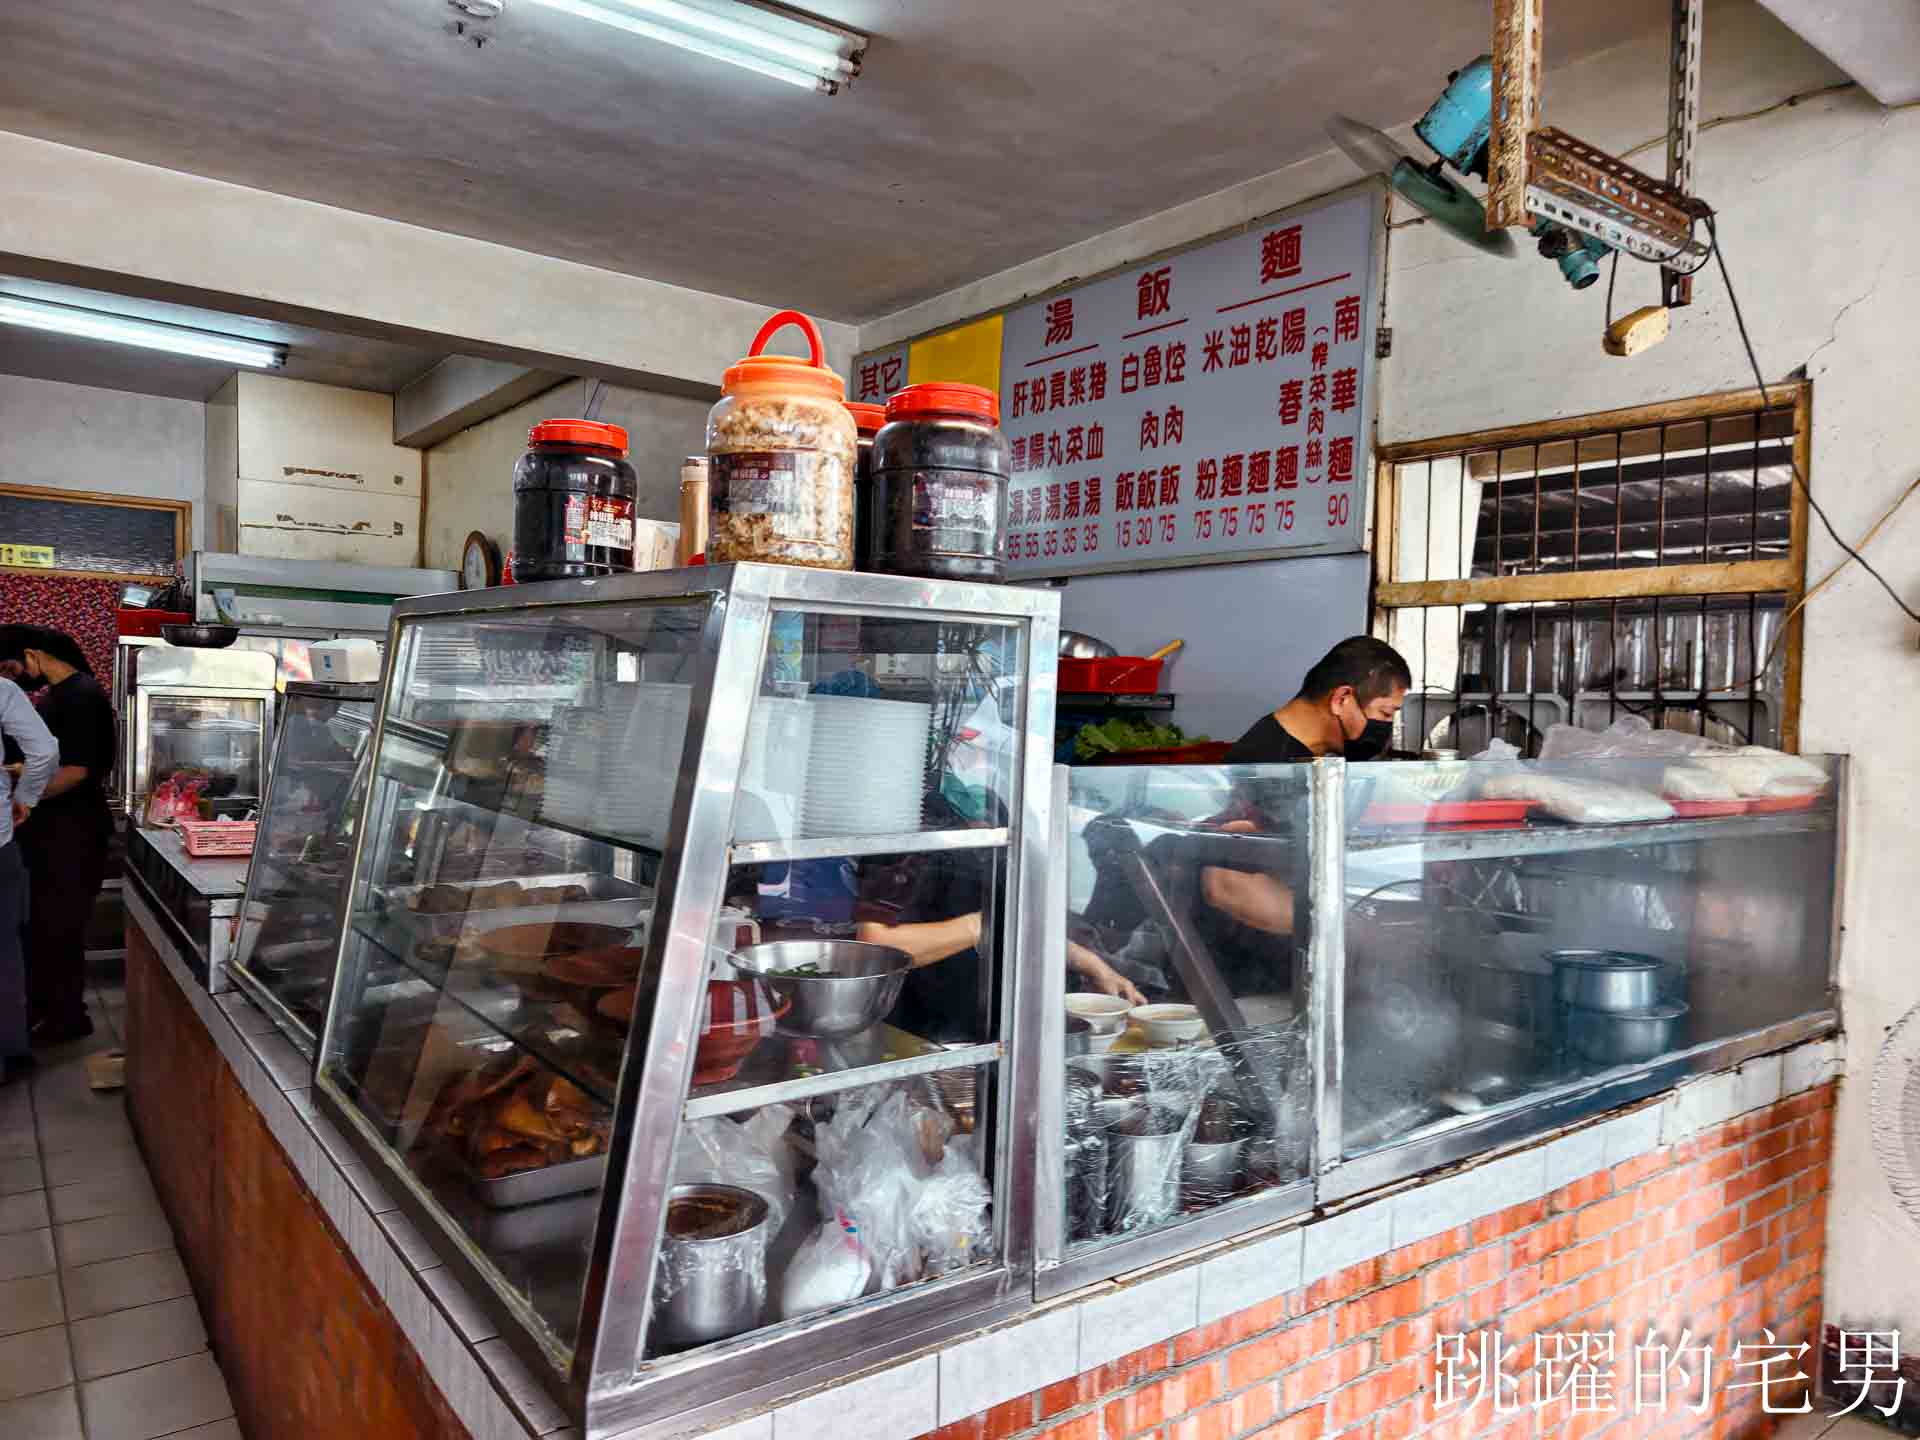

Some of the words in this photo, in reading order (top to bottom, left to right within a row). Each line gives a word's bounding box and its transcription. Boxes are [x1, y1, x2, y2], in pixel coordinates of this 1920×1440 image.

[1260, 224, 1303, 285] 麵
[1136, 266, 1171, 320] 飯
[1045, 298, 1074, 347] 湯
[859, 356, 903, 401] 其它
[1327, 295, 1361, 484] 南華麵
[1195, 330, 1224, 500] 米粉
[1220, 322, 1251, 498] 油麵
[1248, 315, 1279, 495] 乾麵
[1274, 307, 1306, 491] 陽春麵
[1044, 370, 1067, 523] 貢丸湯
[1063, 366, 1086, 520] 紫菜湯
[1115, 352, 1139, 512] 白飯
[1137, 344, 1162, 511] 魯肉飯
[1136, 516, 1153, 545] 30
[1159, 513, 1176, 543] 75
[1194, 509, 1214, 540] 75
[1219, 506, 1239, 537] 75
[1247, 503, 1266, 535] 75
[1275, 500, 1296, 531] 75
[1327, 493, 1350, 528] 90
[1008, 533, 1021, 560] 55
[1025, 532, 1040, 558] 55
[1044, 530, 1058, 556] 35
[1063, 527, 1078, 554] 35
[1084, 523, 1099, 552] 35
[1116, 519, 1131, 548] 15
